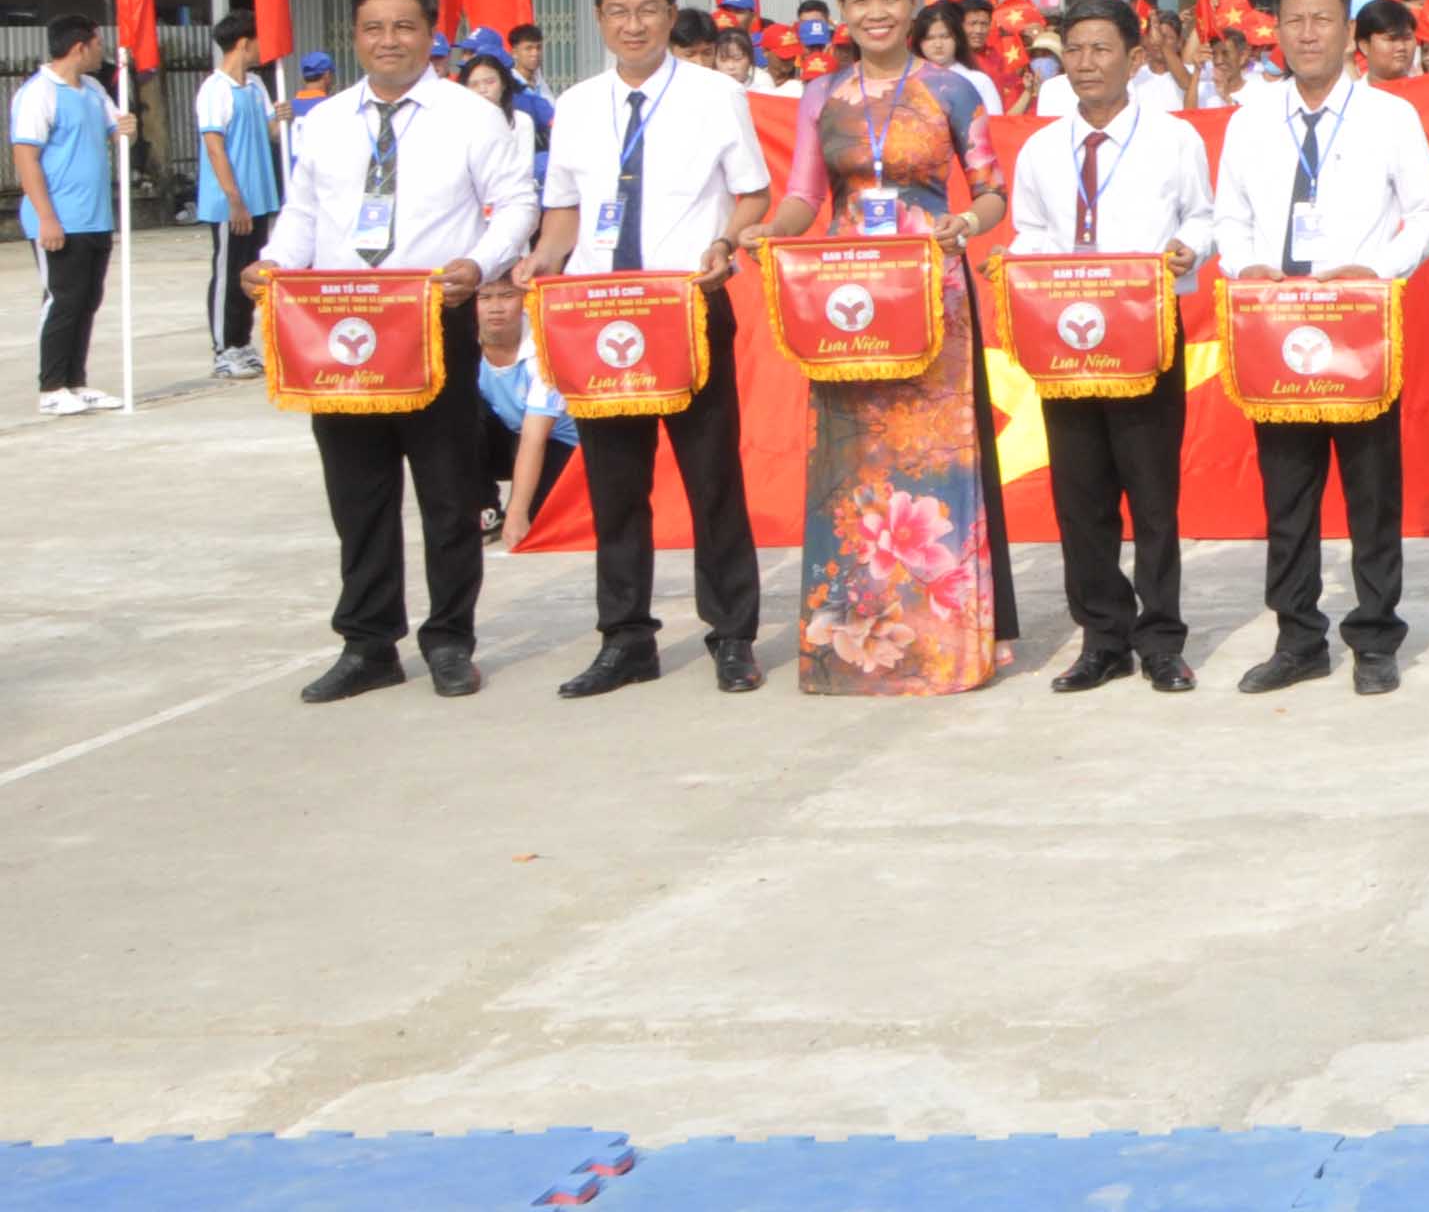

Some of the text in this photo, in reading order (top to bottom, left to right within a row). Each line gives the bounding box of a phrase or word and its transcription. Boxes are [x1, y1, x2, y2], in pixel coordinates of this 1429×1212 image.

[818, 338, 847, 353] Lưu
[1051, 355, 1079, 370] Lưu
[315, 370, 345, 385] Lưu
[588, 375, 616, 389] Lưu
[1272, 380, 1300, 394] Lưu
